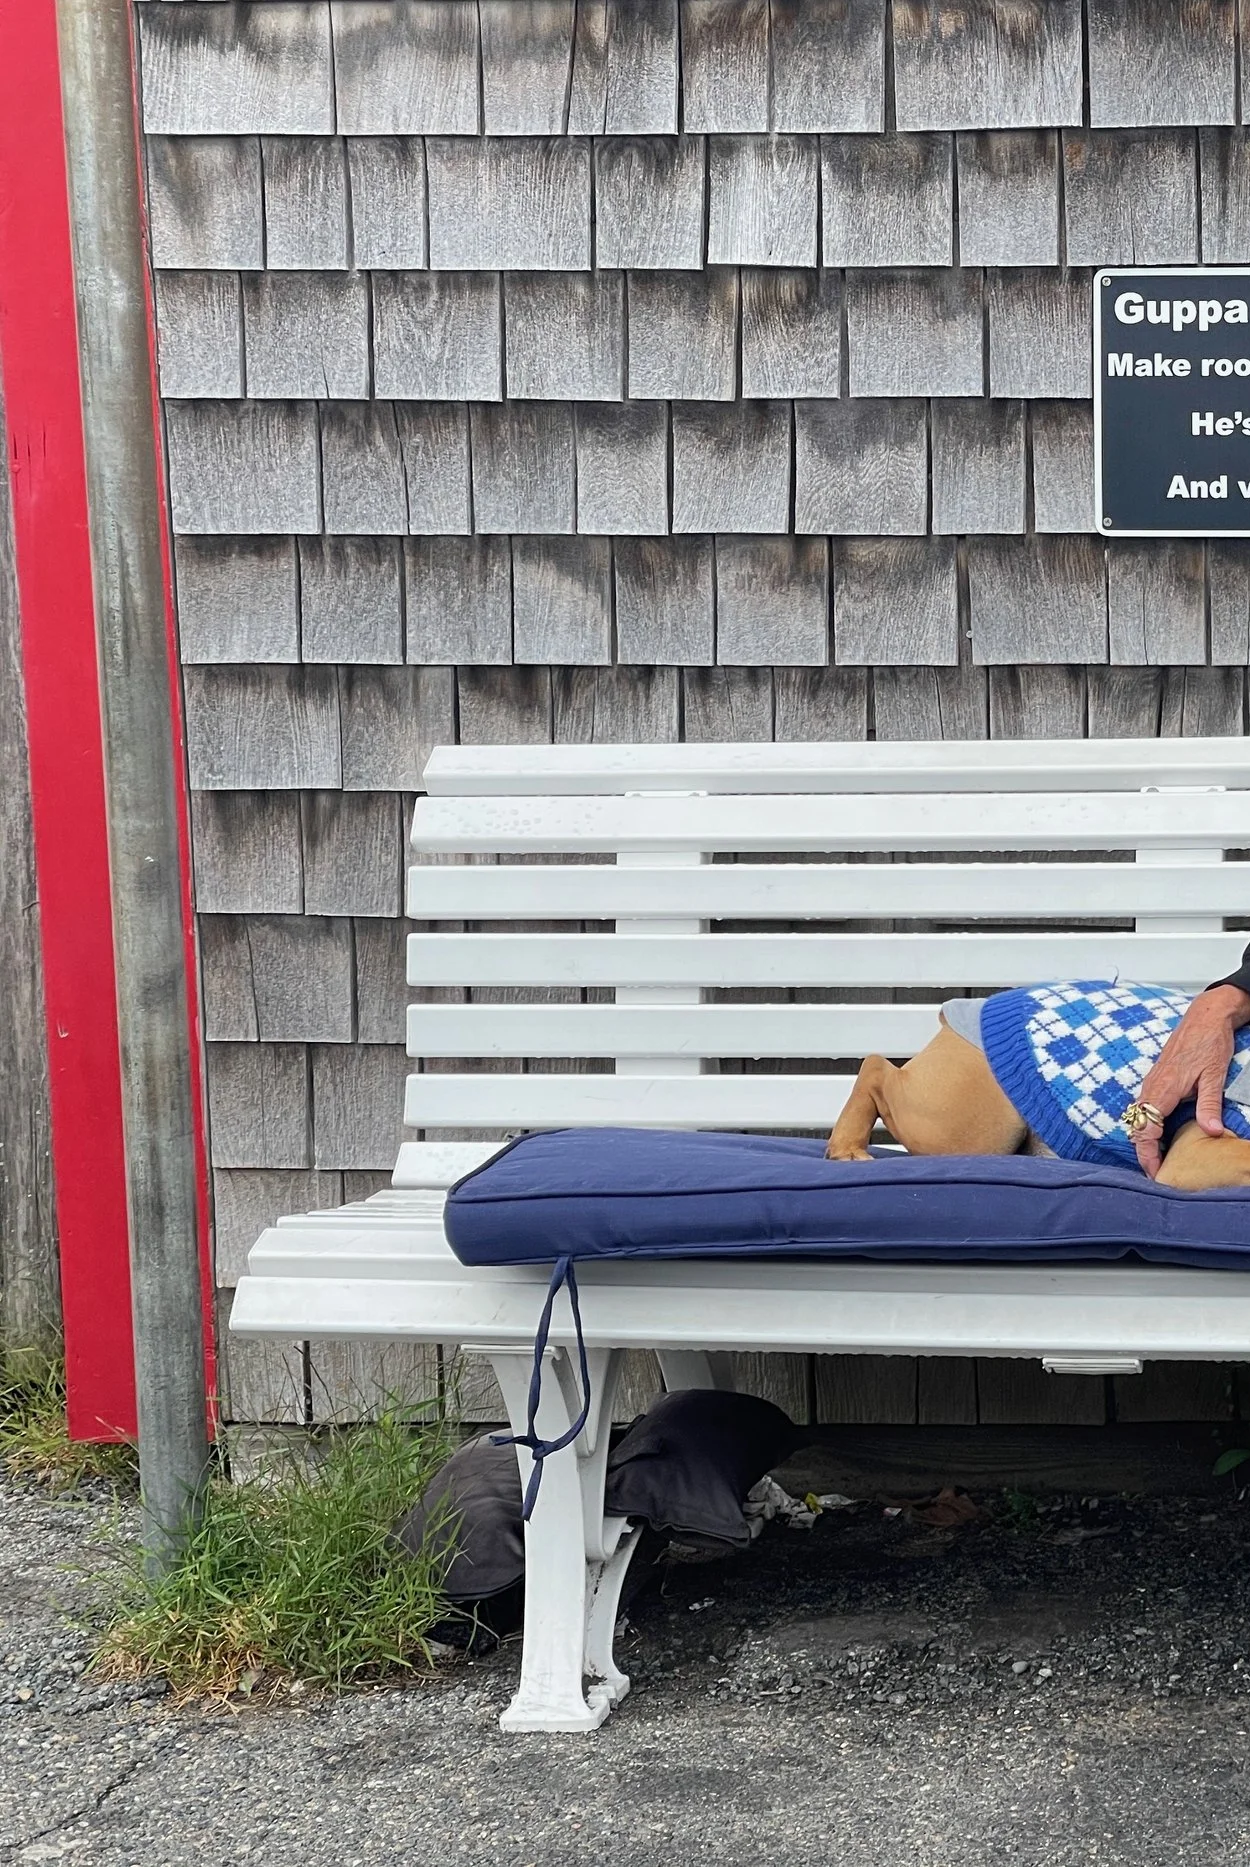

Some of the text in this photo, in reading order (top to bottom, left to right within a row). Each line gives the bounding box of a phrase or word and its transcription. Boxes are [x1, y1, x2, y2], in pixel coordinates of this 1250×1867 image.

[1114, 291, 1249, 332] Guppa
[1107, 352, 1192, 377] Make
[1166, 474, 1228, 499] And
